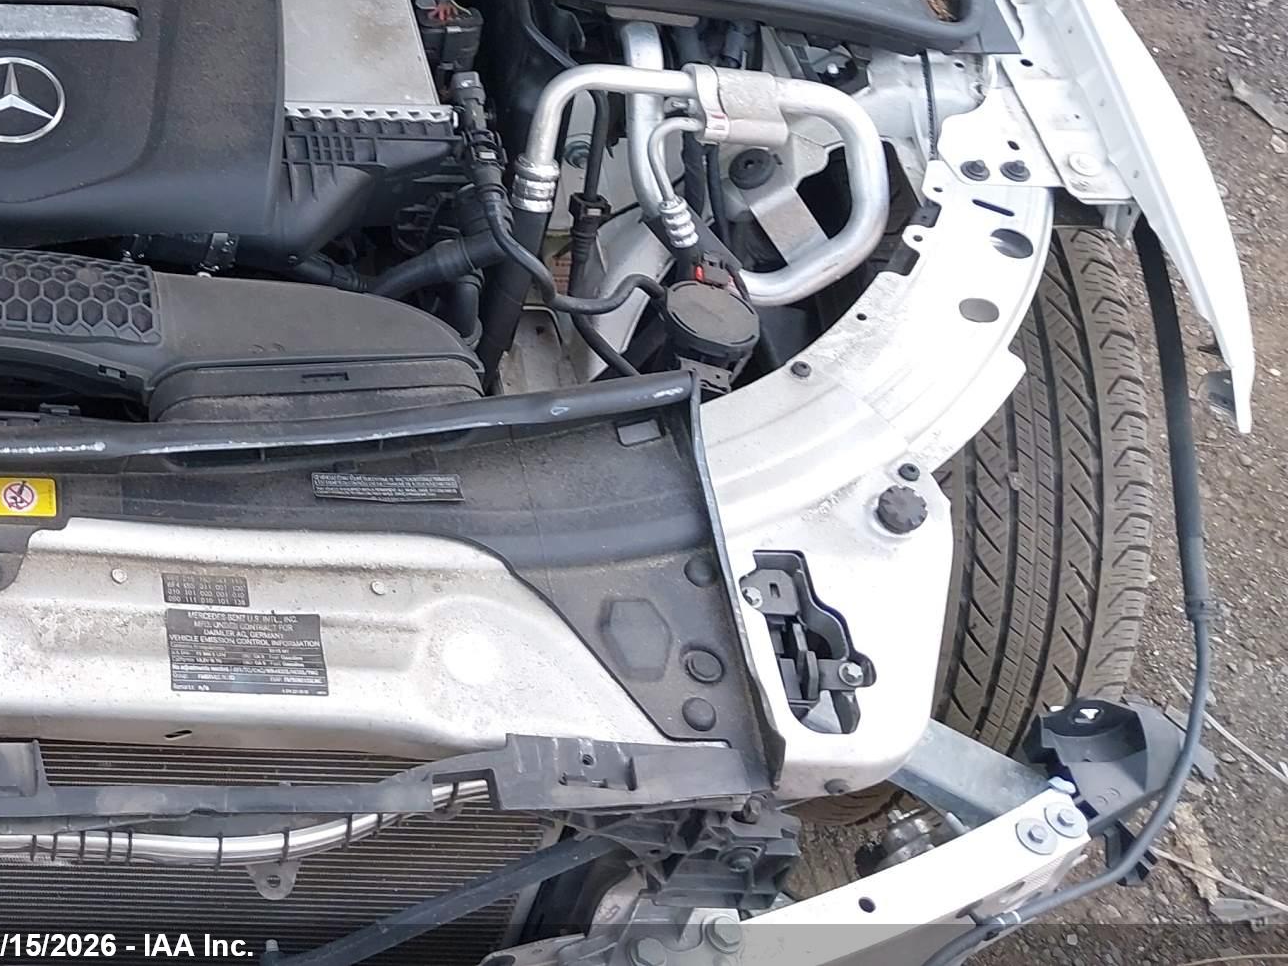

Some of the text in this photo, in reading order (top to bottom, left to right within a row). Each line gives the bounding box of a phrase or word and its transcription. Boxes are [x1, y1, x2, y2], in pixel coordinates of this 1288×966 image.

[278, 624, 294, 632] FOR
[204, 629, 234, 637] DAIMLER
[250, 631, 284, 640] GERMANY
[169, 634, 320, 648] VEHICLE EMISSION CONTROL INFORMATION
